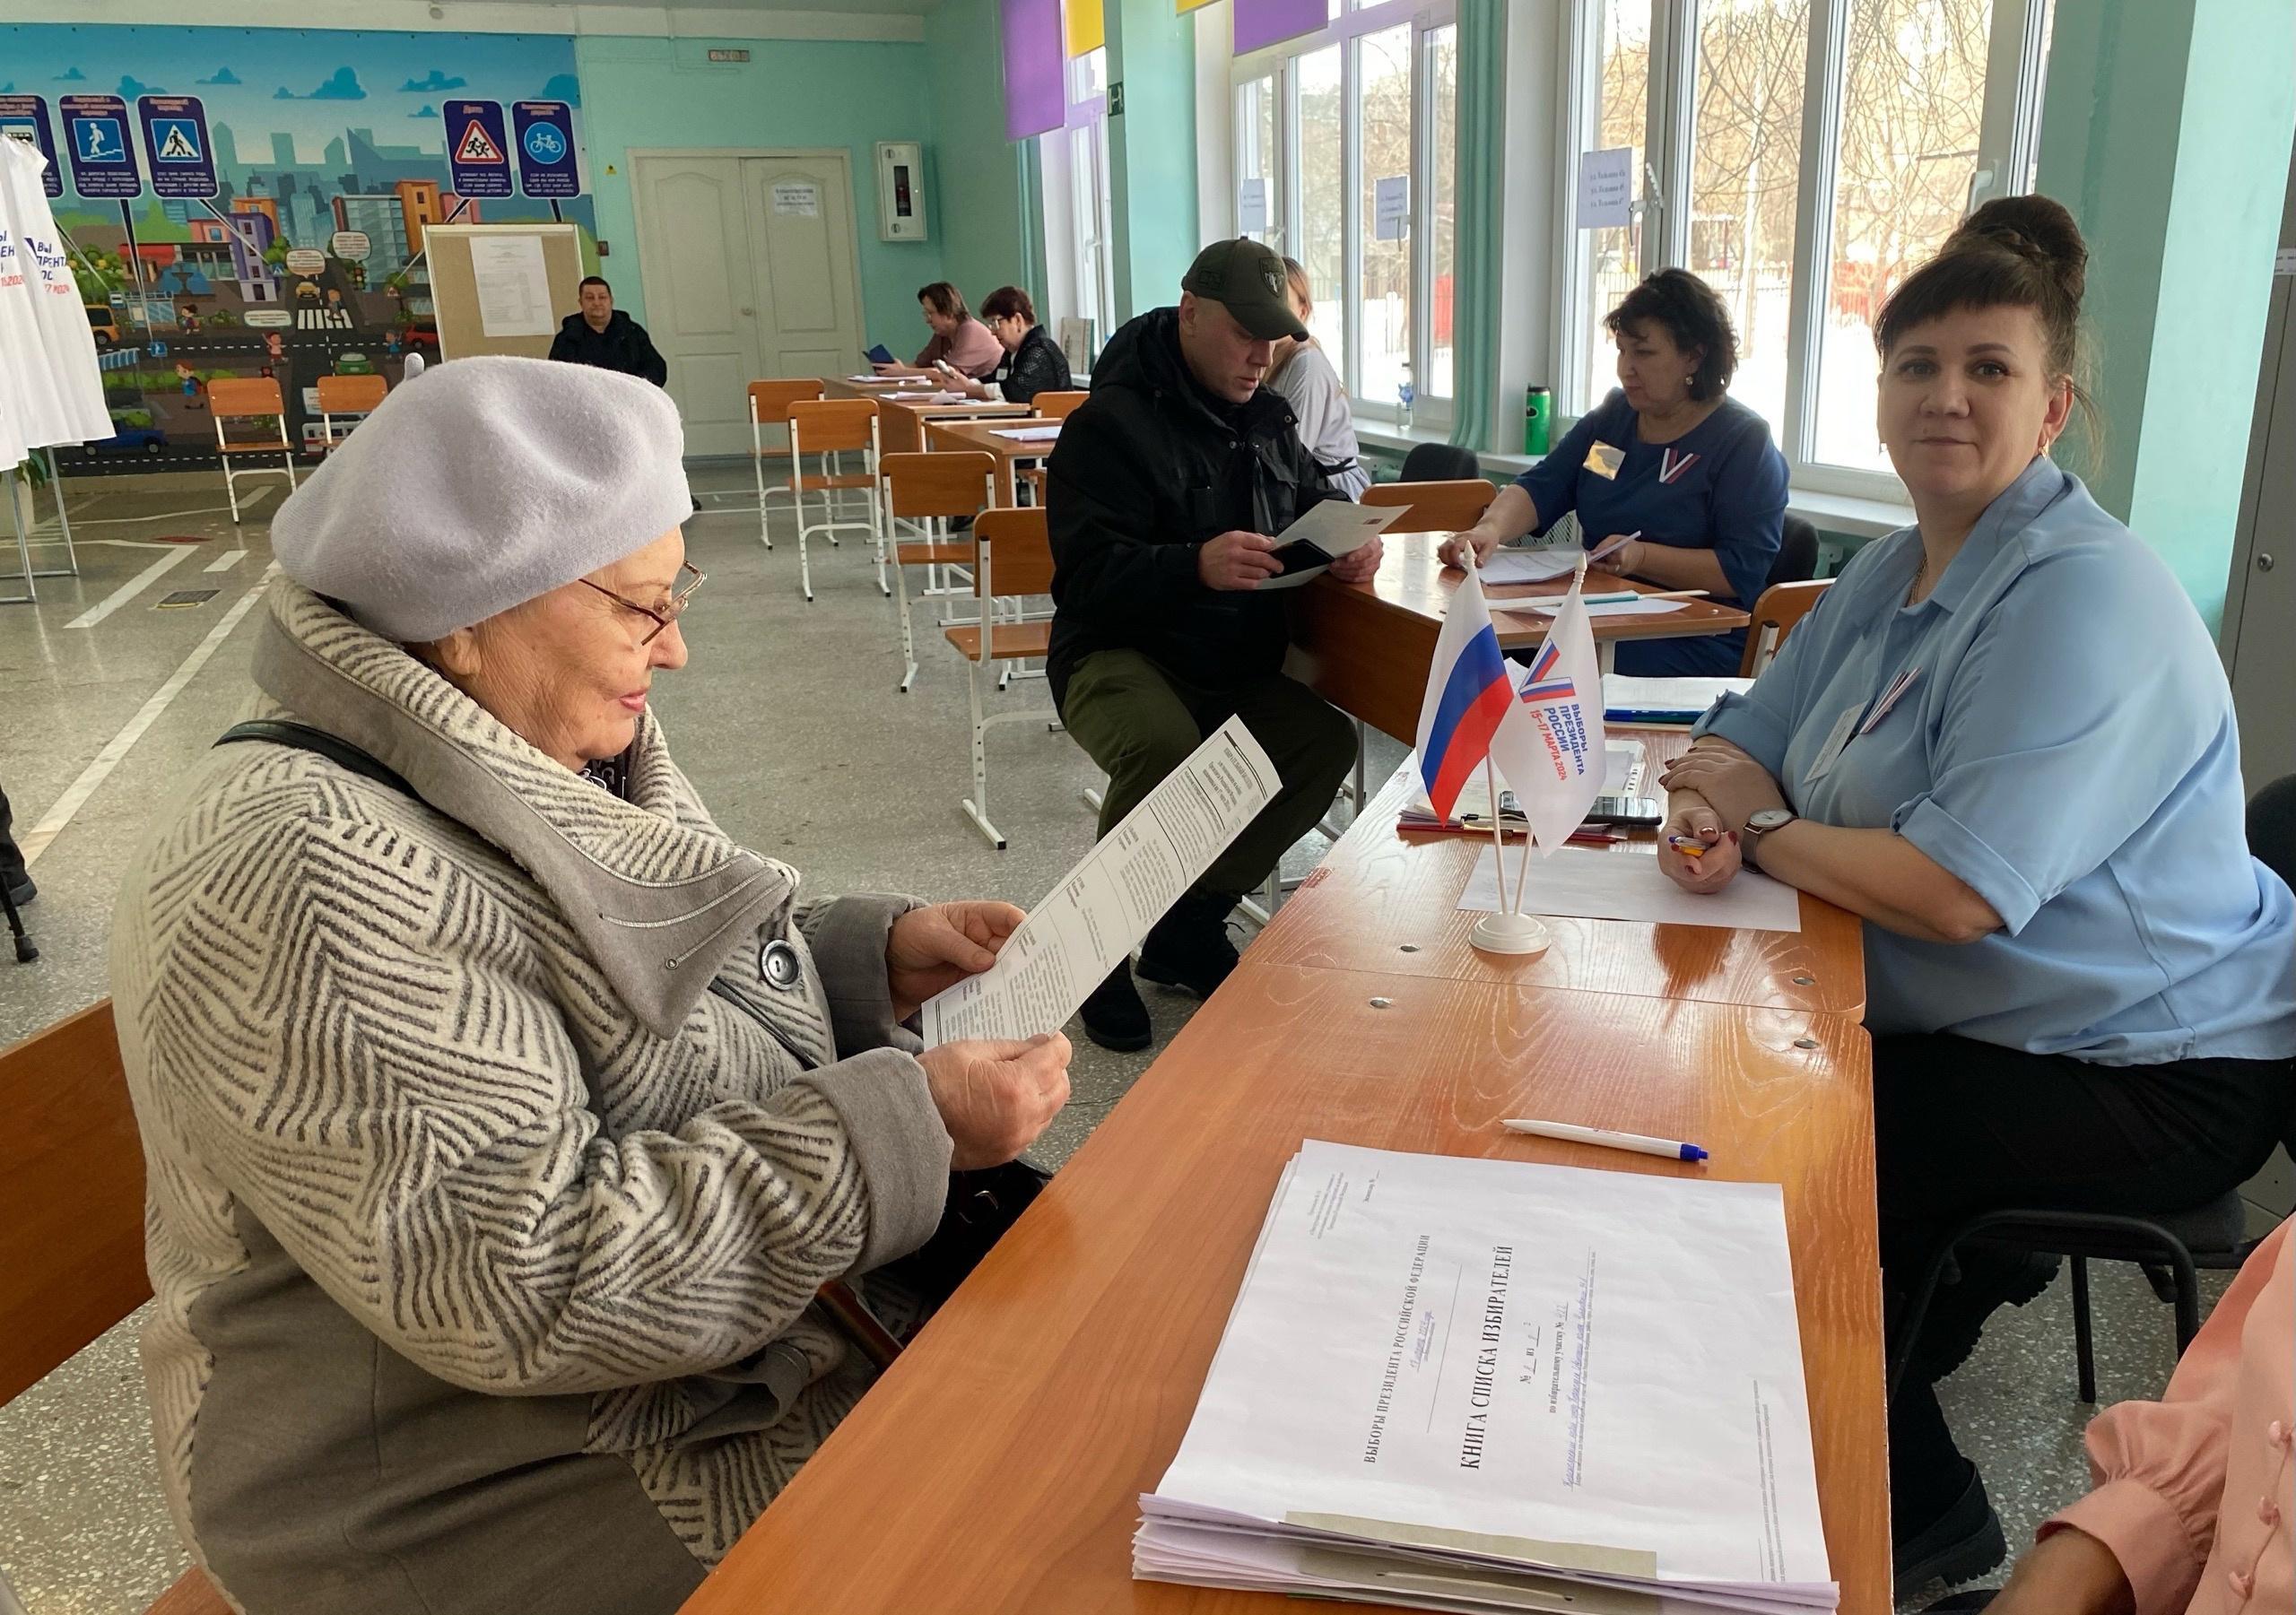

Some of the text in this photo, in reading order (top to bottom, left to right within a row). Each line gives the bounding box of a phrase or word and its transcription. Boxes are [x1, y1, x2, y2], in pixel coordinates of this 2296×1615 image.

[1544, 708, 1570, 751] РОССИИ
[1559, 706, 1584, 775] ПРЕЗИДЕНТА
[1571, 704, 1587, 751] ВЫБОРЫ
[1542, 733, 1561, 760] МАРТА
[1555, 761, 1567, 780] 2024
[1363, 1235, 1430, 1463] ВЫБОРЫ ПРЕЗИДЕНТА РОССИЙСКОЙ ФЕДЕРАЦИИ
[1460, 1246, 1513, 1471] КНИГА СПИСКА ИЗБИРАТЕЛЕЙ
[1555, 1329, 1565, 1355] участку
[1519, 1376, 1531, 1384] №
[1526, 1348, 1535, 1357] из
[1548, 1356, 1563, 1404] избирательному
[1550, 1405, 1556, 1413] по
